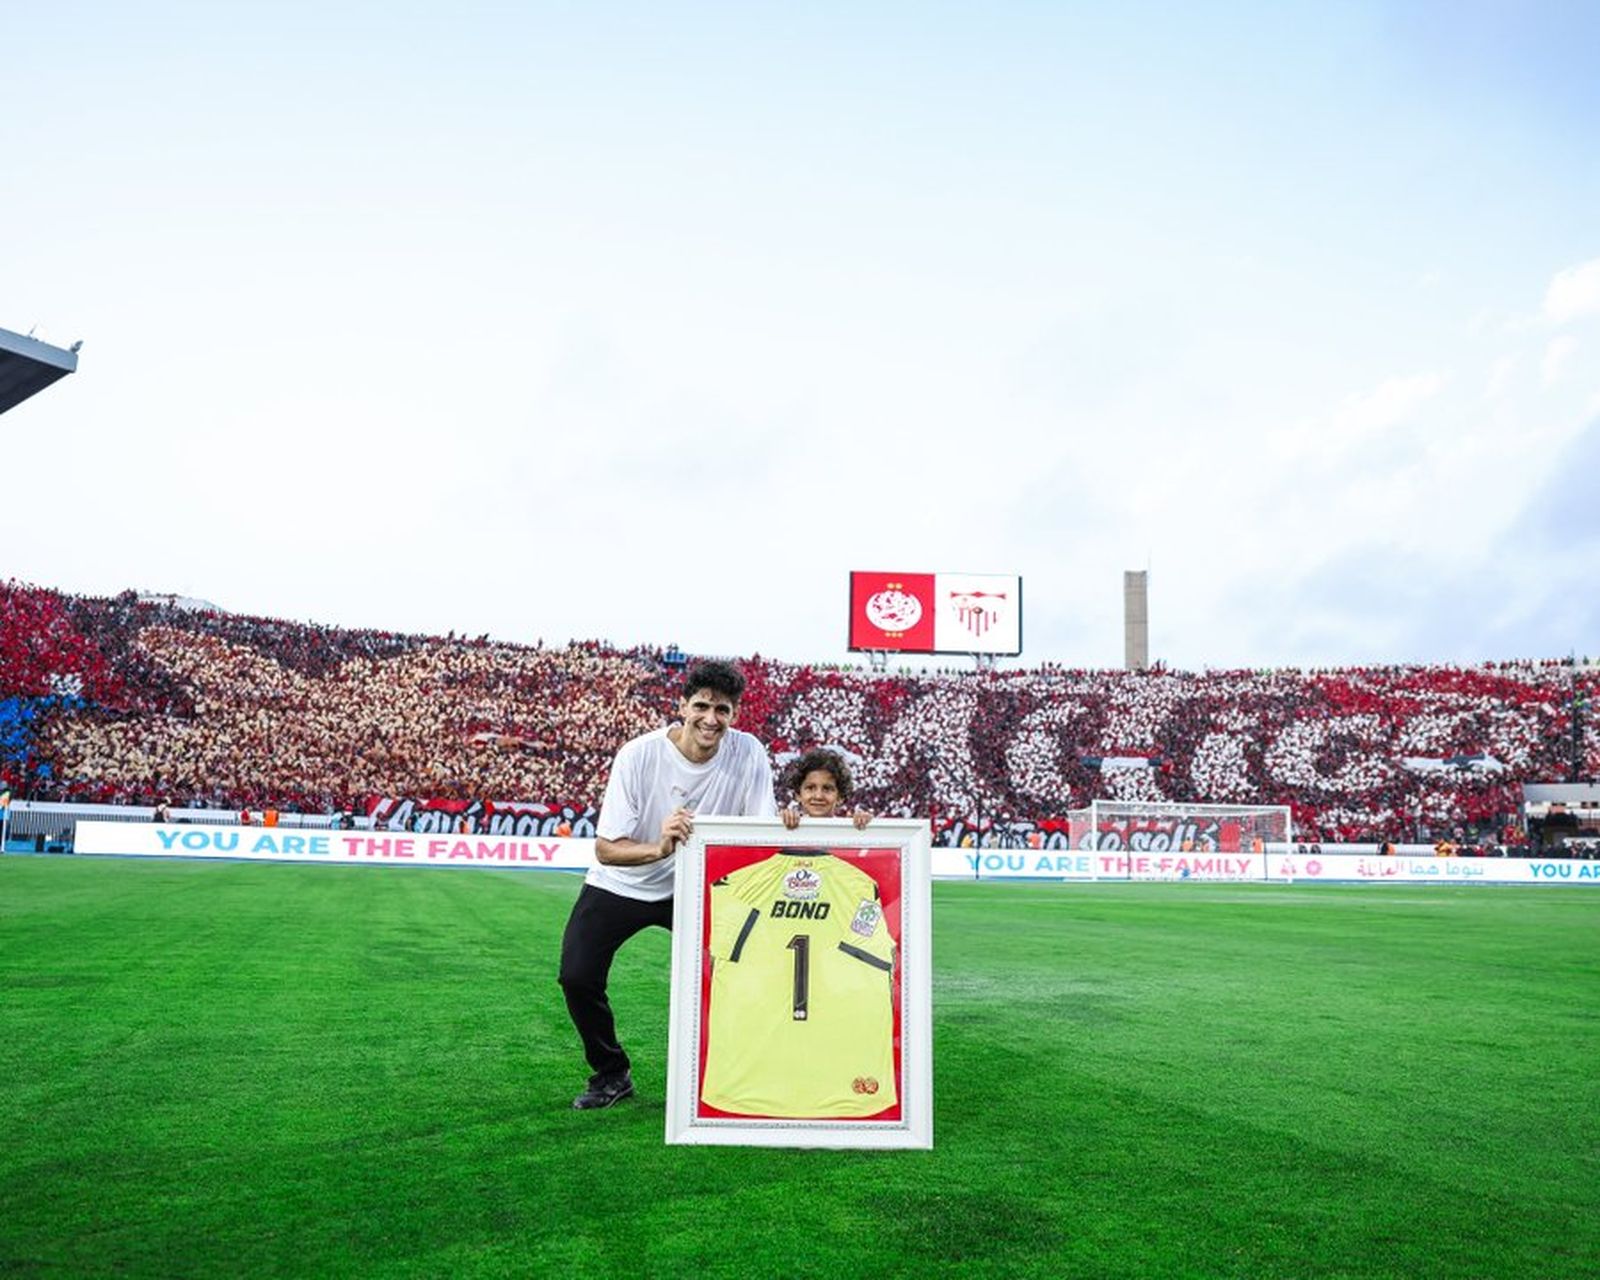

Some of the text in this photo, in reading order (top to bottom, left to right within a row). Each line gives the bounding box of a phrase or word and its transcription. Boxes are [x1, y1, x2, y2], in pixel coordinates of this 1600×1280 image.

[155, 829, 560, 862] YOU ARE THE FAMILY
[965, 854, 1252, 875] YOU ARE THE FAMILY
[1529, 863, 1571, 878] YOU
[770, 900, 831, 920] BONO
[786, 934, 810, 1021] 1
